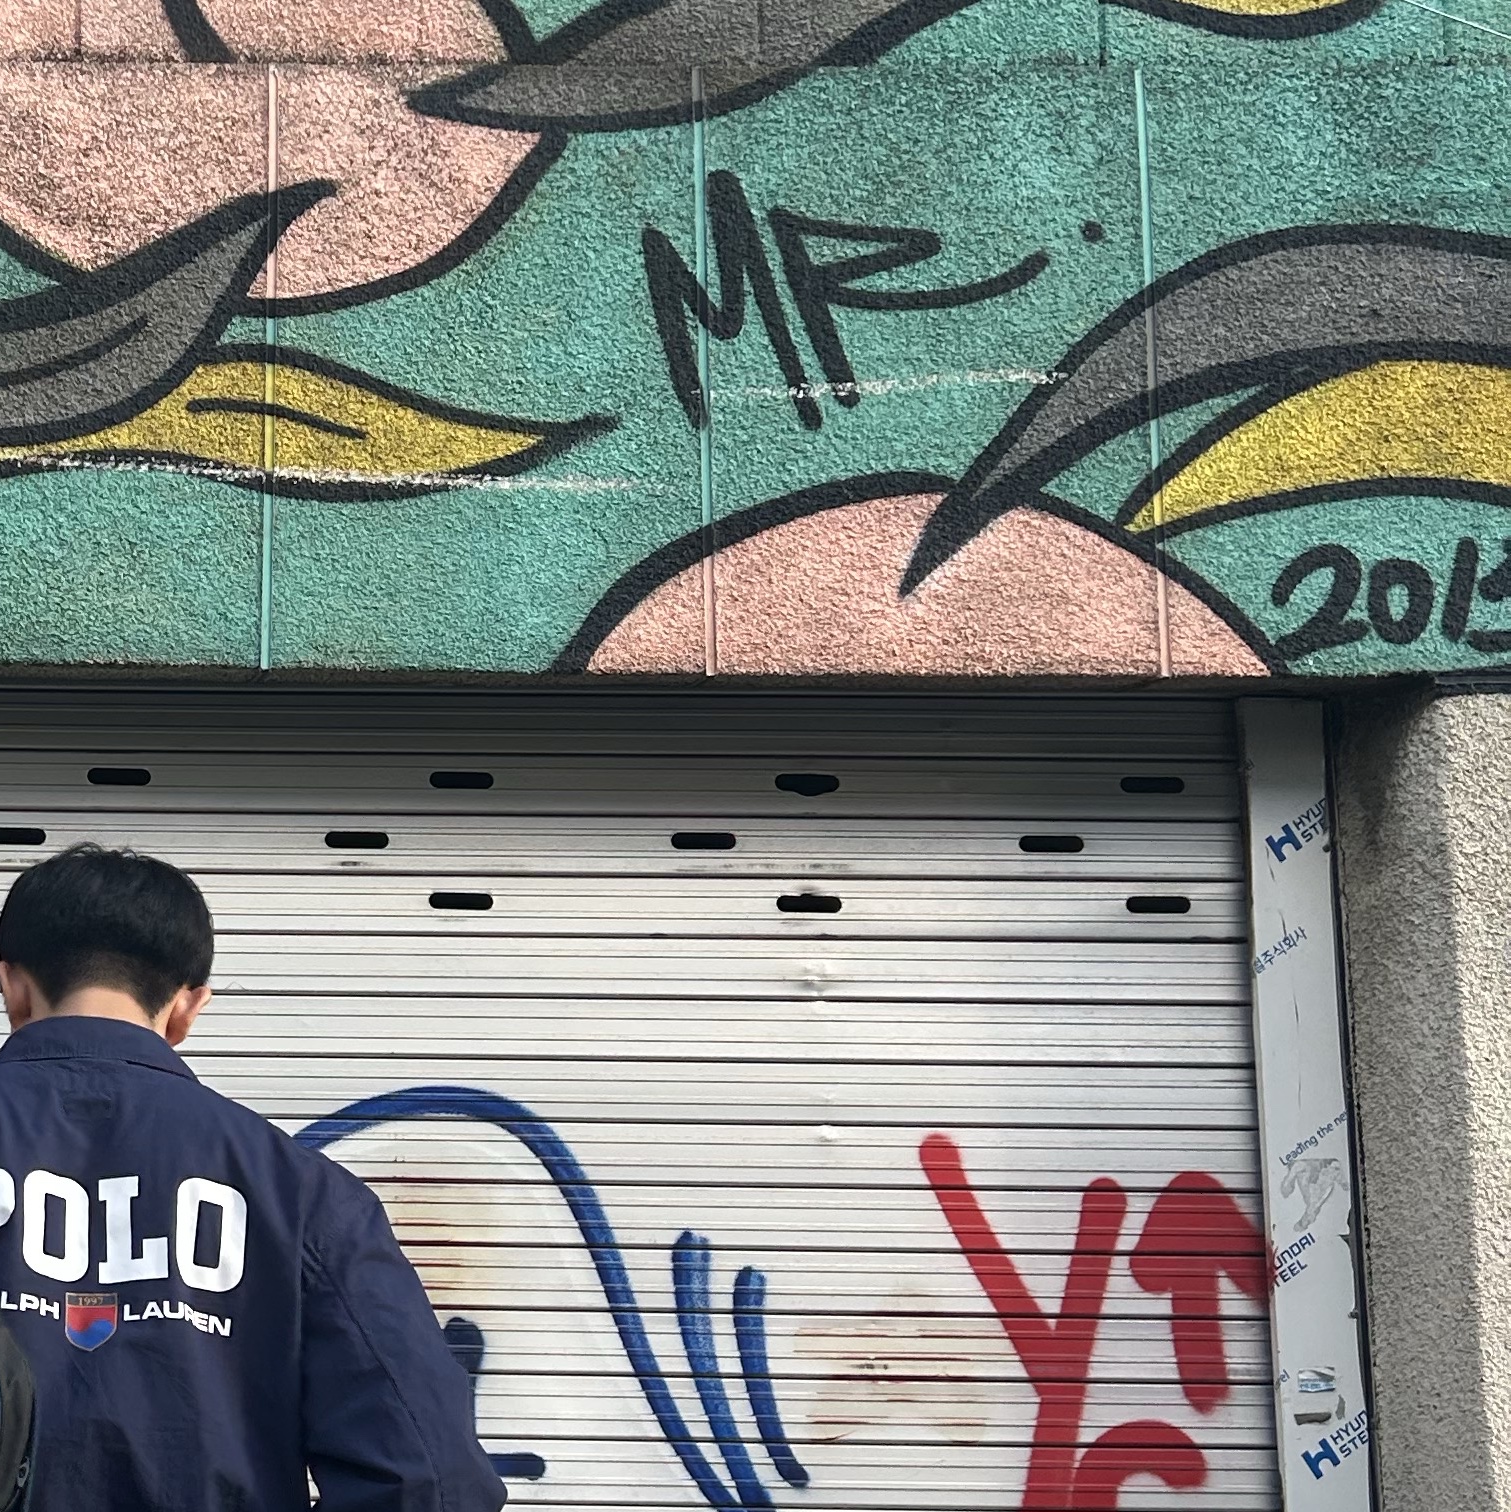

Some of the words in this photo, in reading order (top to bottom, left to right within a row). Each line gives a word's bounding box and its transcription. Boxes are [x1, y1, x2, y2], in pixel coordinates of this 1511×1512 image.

[1278, 1135, 1319, 1166] Leading
[1316, 1123, 1334, 1139] the
[123, 1300, 232, 1337] LAUREN
[1339, 1427, 1369, 1459] STE
